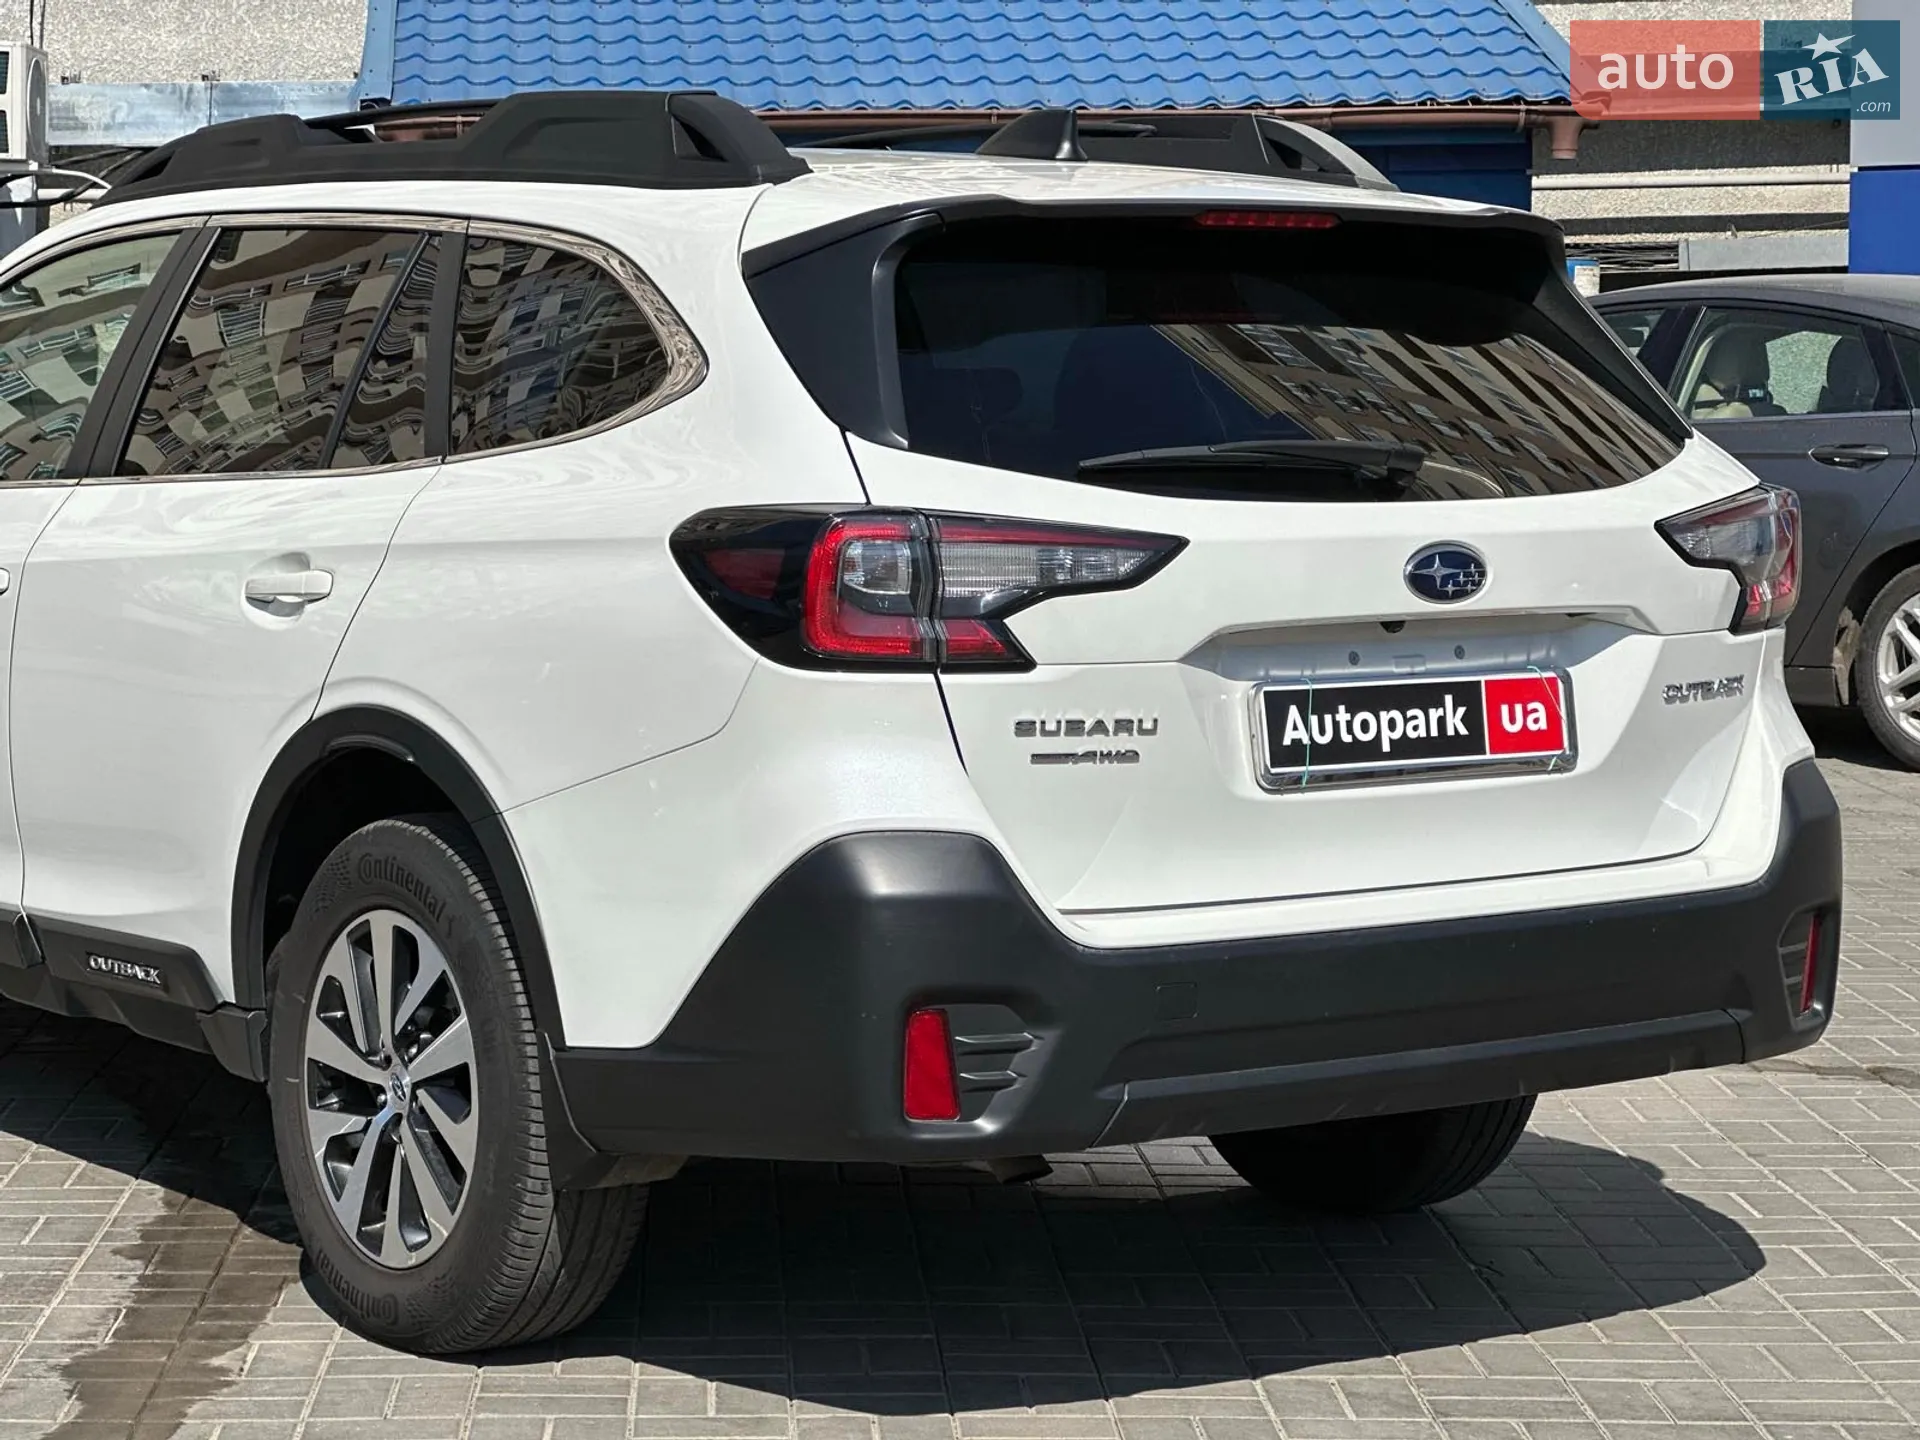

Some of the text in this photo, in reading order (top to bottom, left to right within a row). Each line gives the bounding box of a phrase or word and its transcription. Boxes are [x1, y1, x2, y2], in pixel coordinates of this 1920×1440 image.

[1014, 717, 1159, 738] SUBARU
[1283, 694, 1548, 753] Autopark ua
[357, 852, 447, 923] Continental
[88, 955, 161, 985] OUTBACK
[315, 1248, 400, 1327] Continental
